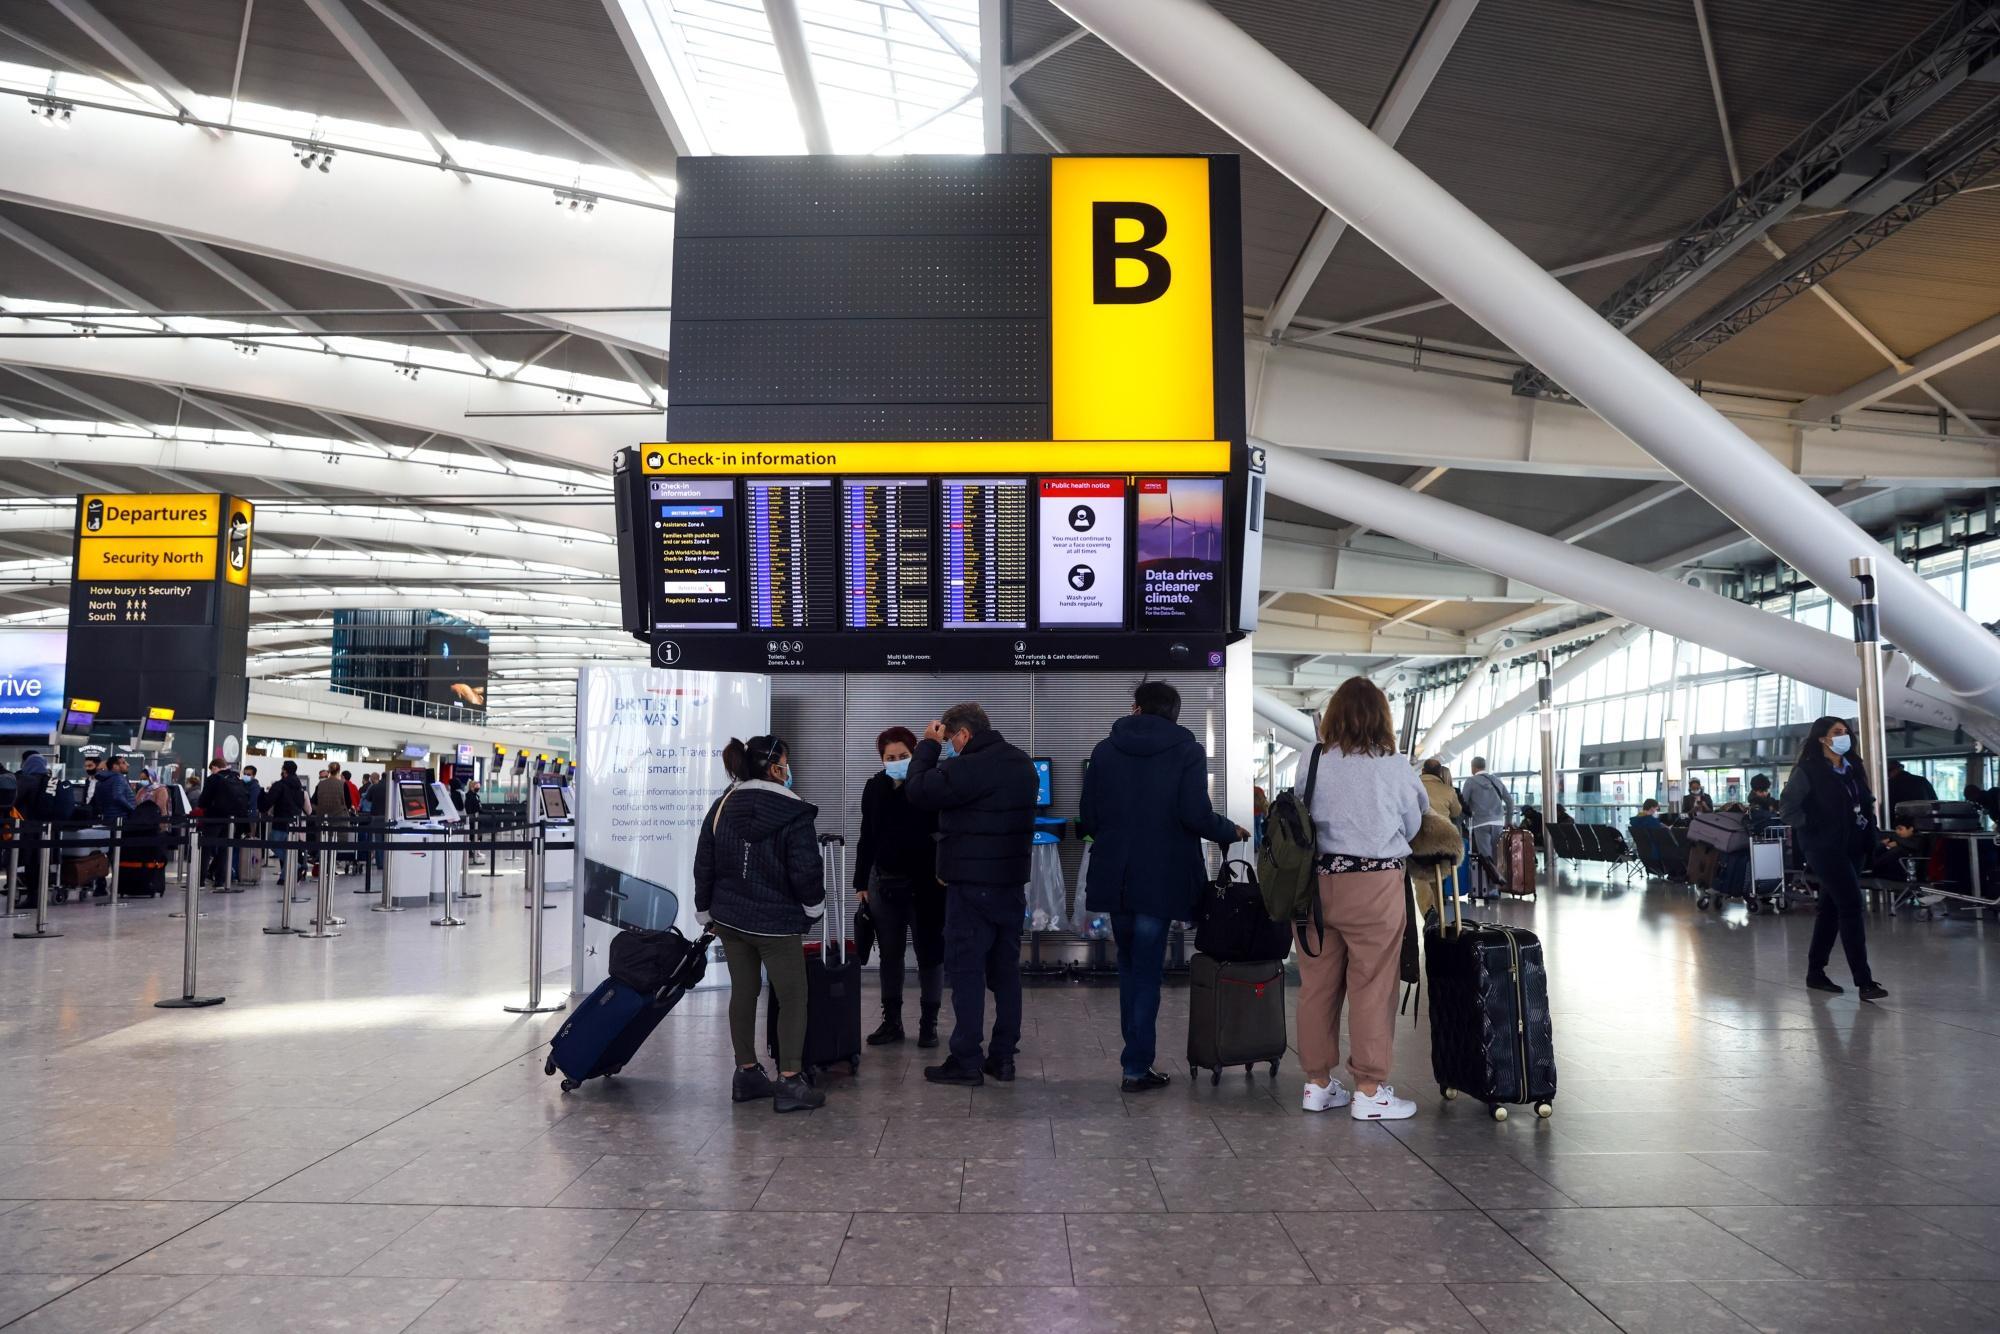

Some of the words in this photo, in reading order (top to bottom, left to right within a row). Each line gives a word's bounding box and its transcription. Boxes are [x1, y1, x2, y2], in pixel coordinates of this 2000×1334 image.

[1092, 202, 1171, 305] B
[667, 452, 736, 466] Check-in
[741, 452, 837, 466] information
[106, 506, 207, 524] Departures
[103, 551, 160, 566] Security
[163, 551, 204, 564] North
[1145, 570, 1175, 581] Data
[1176, 570, 1214, 581] drives
[89, 586, 113, 595] How
[114, 586, 137, 597] busy
[139, 586, 146, 595] is
[148, 586, 192, 597] Security?
[1145, 584, 1153, 592] a
[1154, 582, 1201, 592] cleaner
[1145, 592, 1193, 604] climate.
[89, 601, 116, 610] North
[88, 612, 116, 621] South
